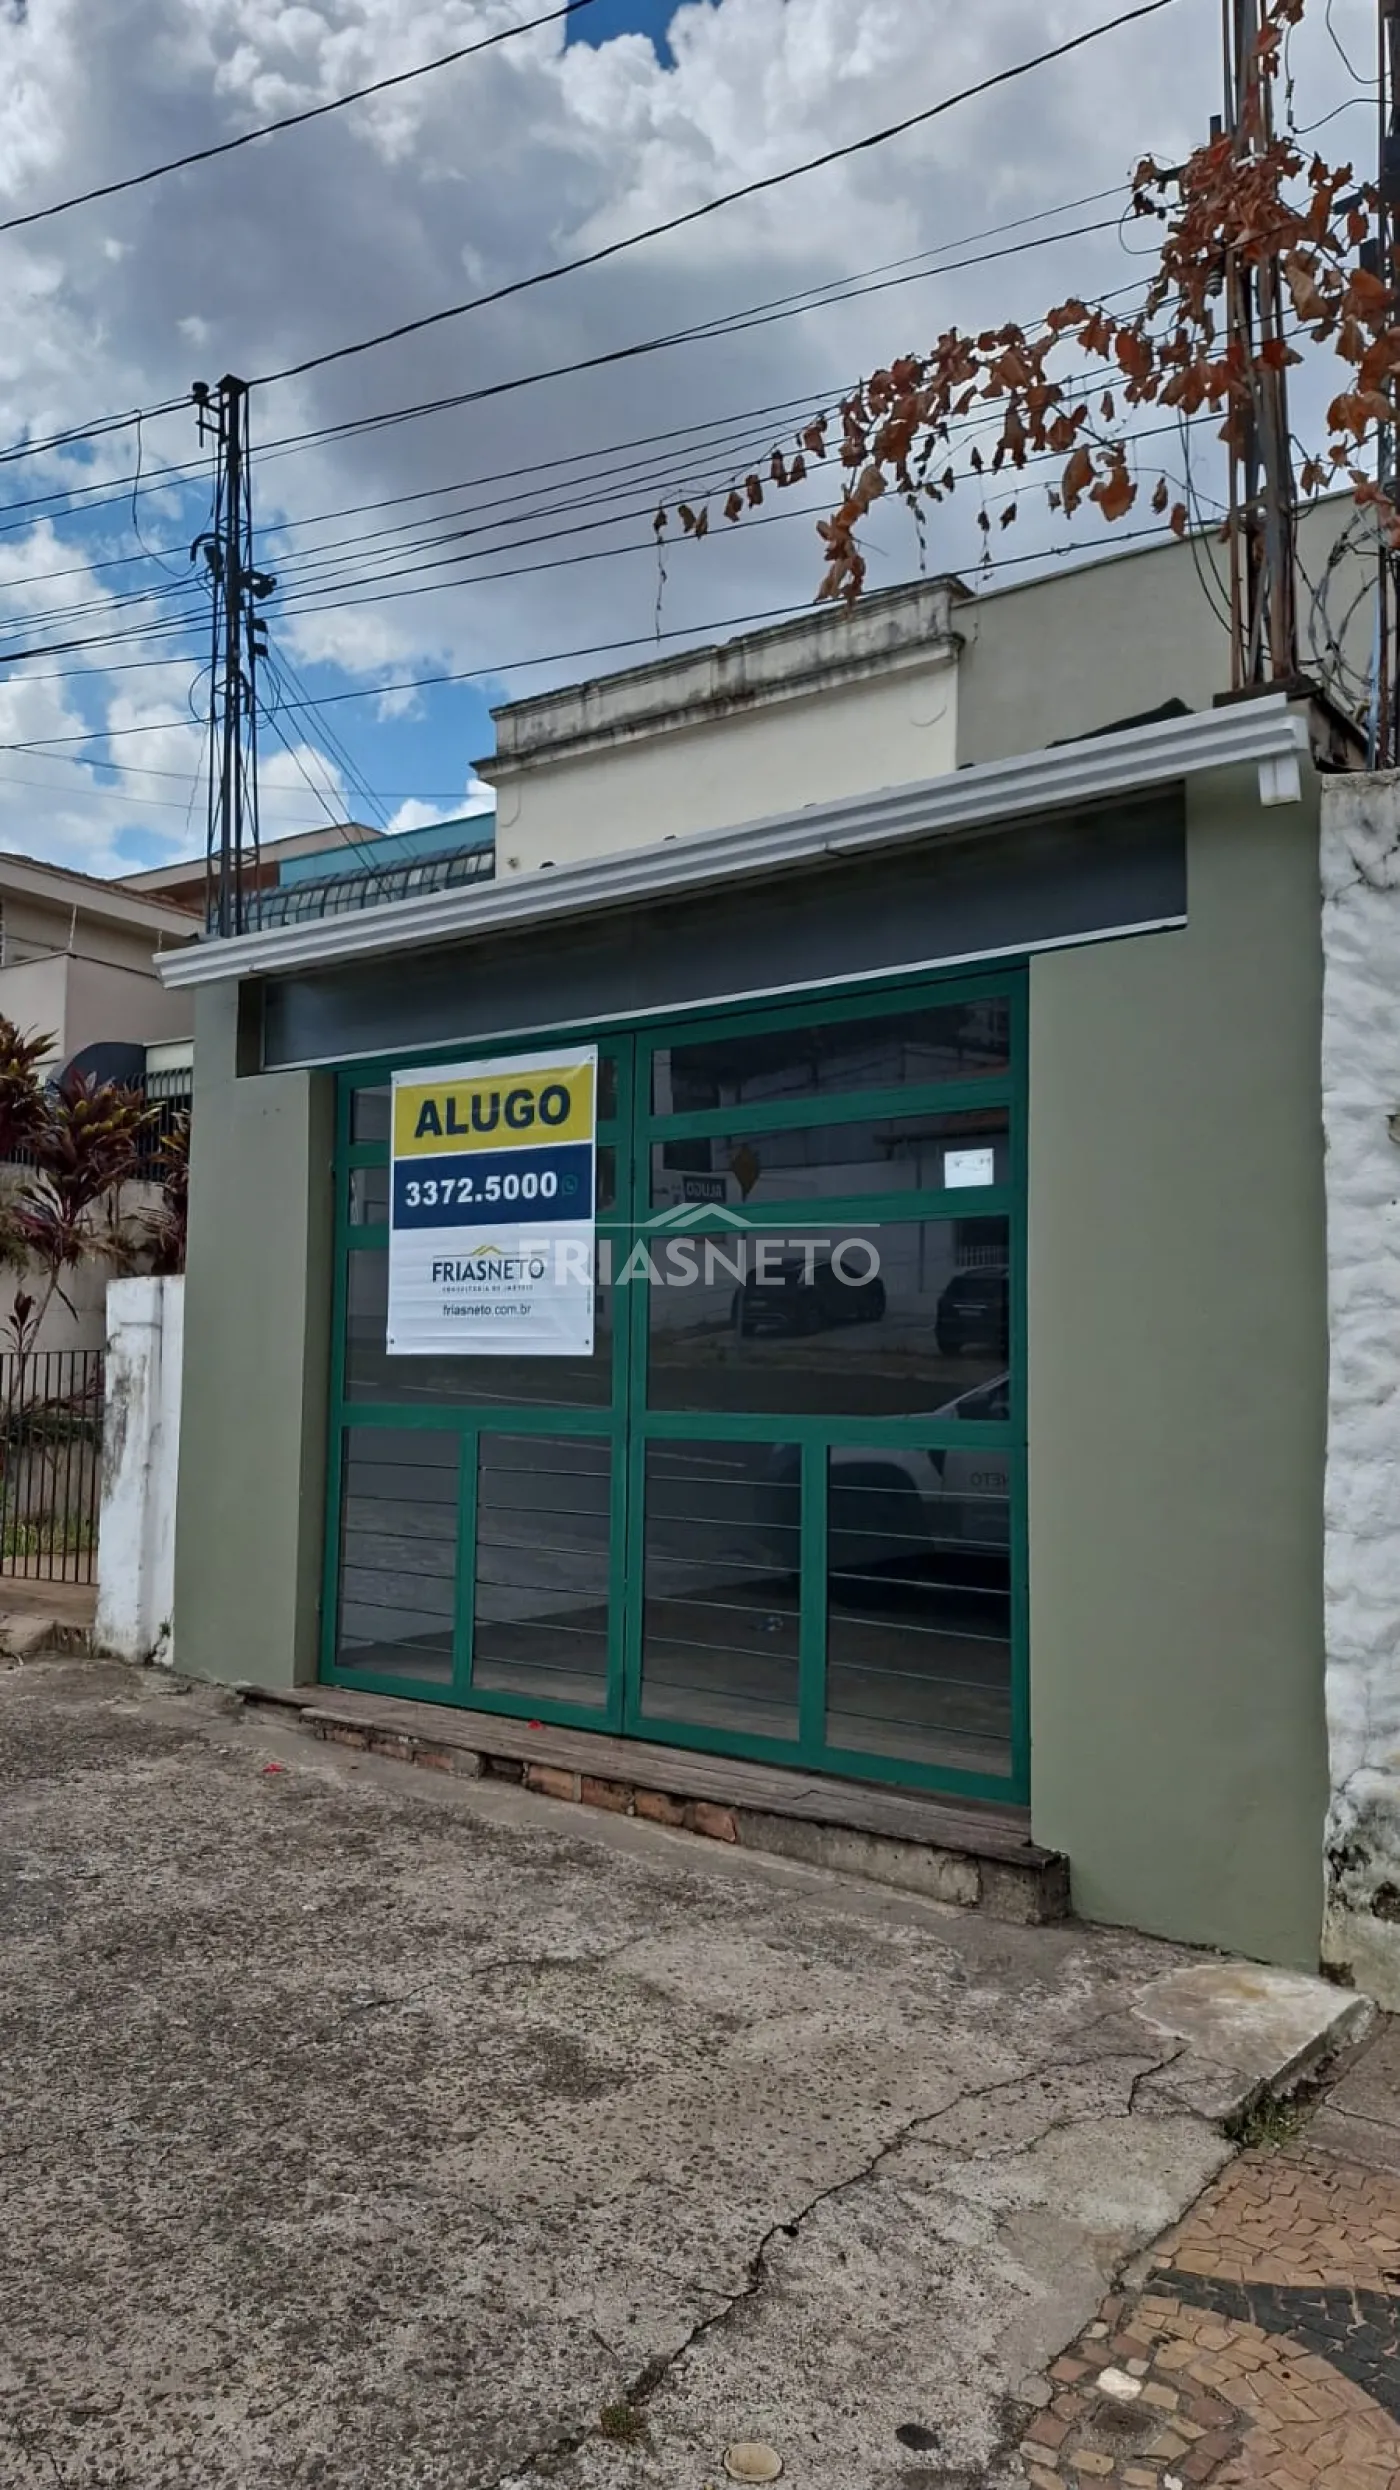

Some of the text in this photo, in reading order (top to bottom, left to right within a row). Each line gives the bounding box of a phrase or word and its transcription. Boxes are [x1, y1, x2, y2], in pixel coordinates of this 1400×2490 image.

[414, 1083, 571, 1138] ALUGO
[405, 1171, 558, 1207] 3372.5000
[432, 1258, 545, 1282] FRIASNETO
[443, 1303, 532, 1316] friasneto.com.br
